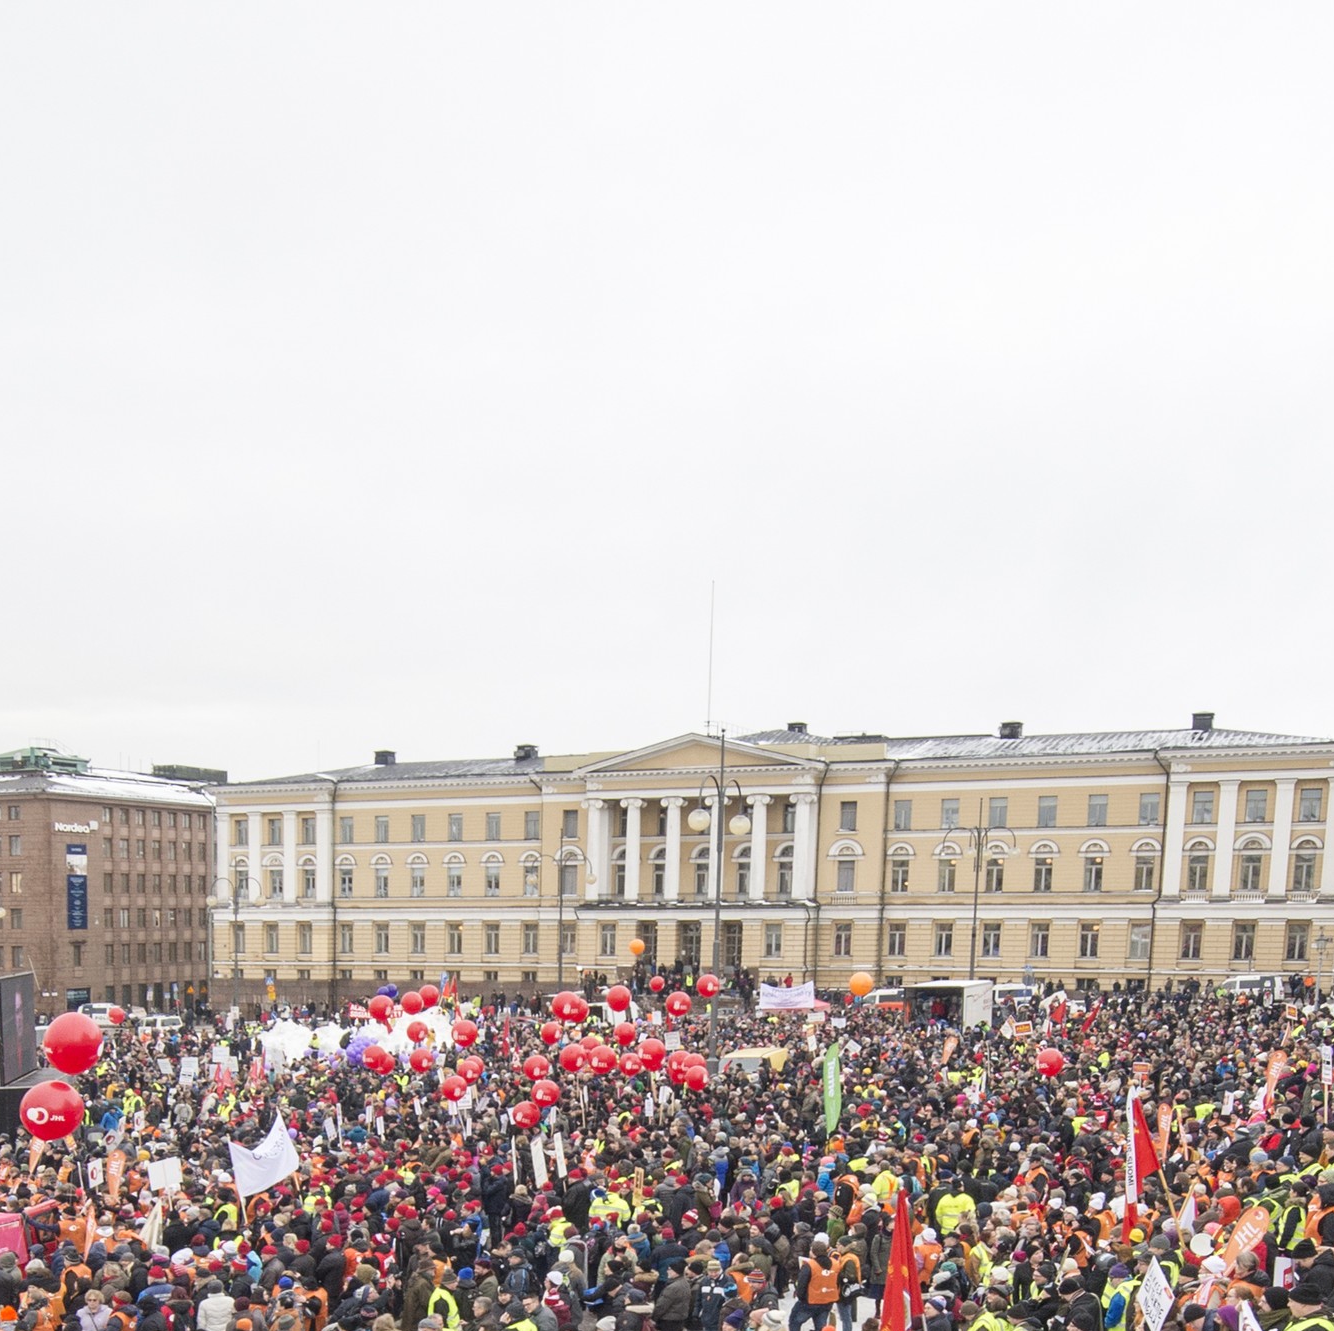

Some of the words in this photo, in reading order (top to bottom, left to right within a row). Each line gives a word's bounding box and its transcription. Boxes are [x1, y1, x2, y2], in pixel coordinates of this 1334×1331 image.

[54, 821, 90, 833] Nordea
[50, 1114, 66, 1122] JHL
[1234, 1221, 1260, 1249] JHL
